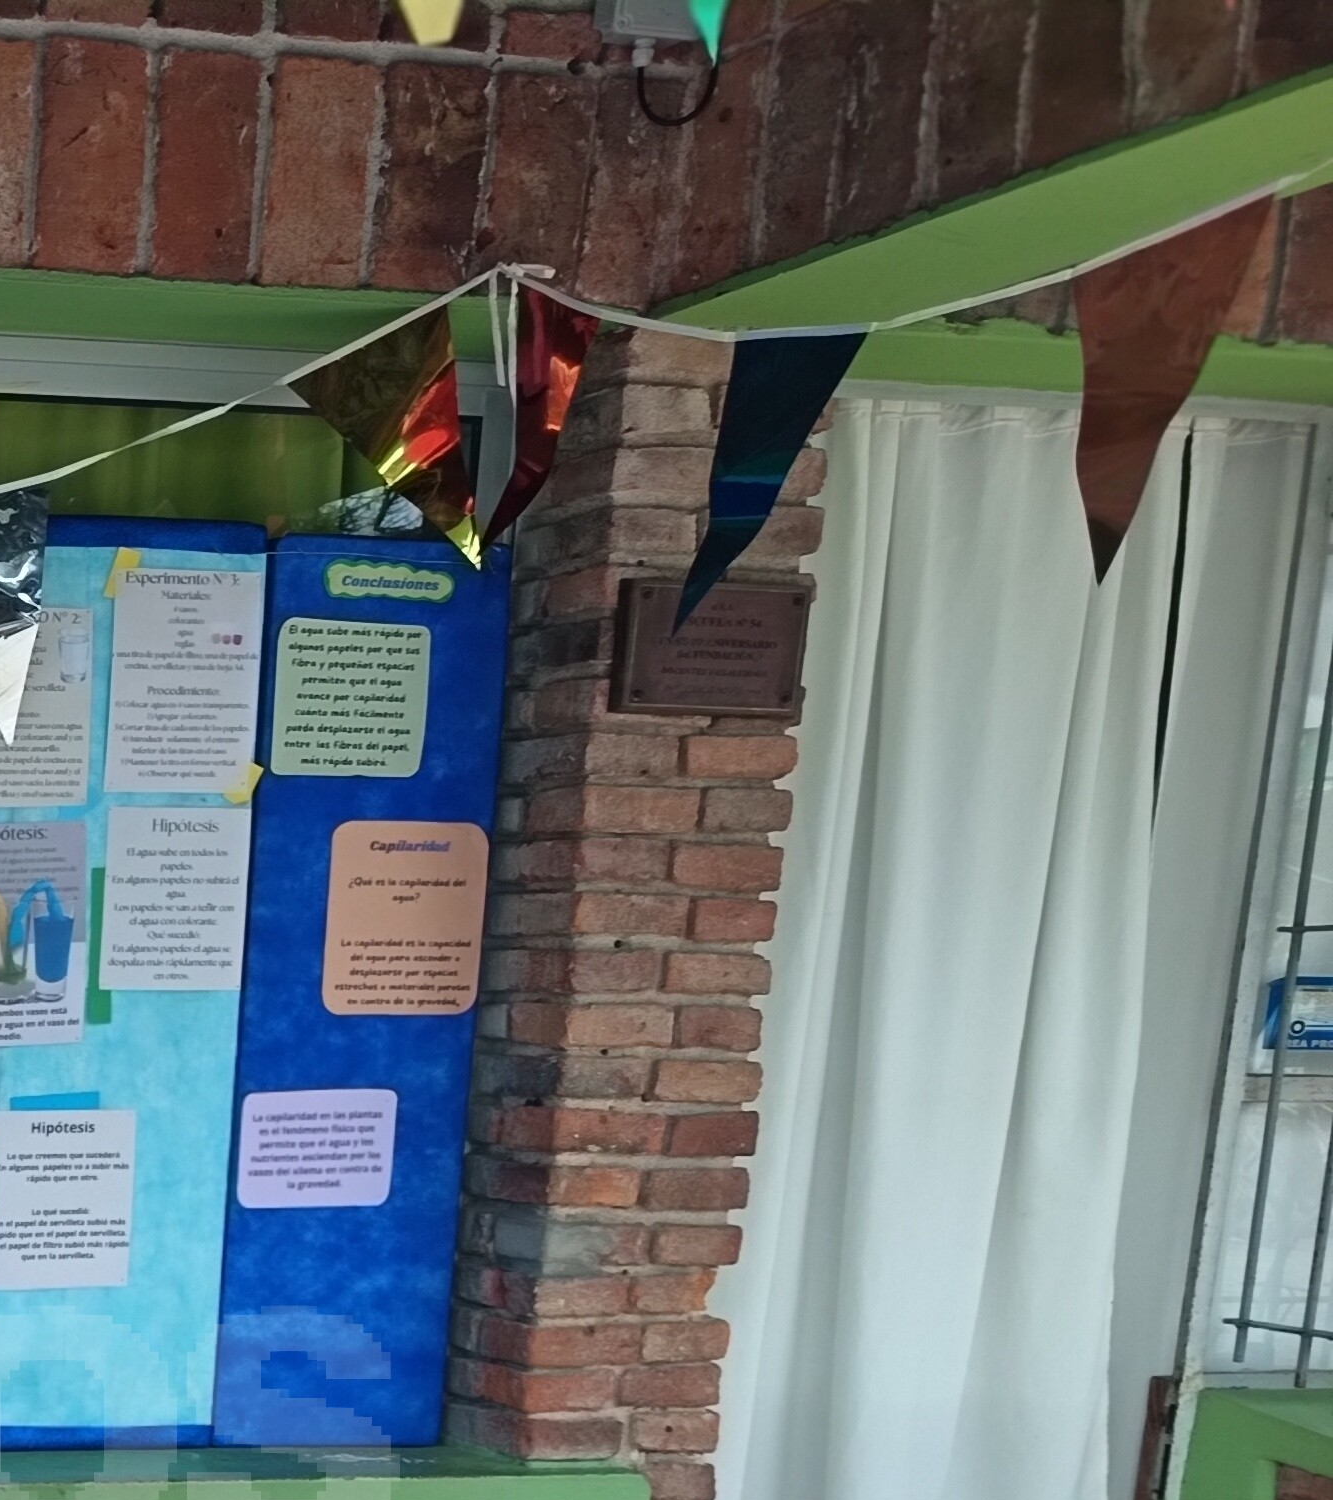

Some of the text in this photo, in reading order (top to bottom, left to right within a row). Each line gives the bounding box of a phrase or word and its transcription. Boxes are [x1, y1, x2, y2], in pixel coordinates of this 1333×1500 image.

[125, 571, 210, 587] Experimento
[342, 575, 439, 591] Conclusiones
[289, 624, 422, 641] El agua sube más rápido por
[289, 643, 420, 656] algunos papeles por que sus
[302, 676, 402, 688] permiten que el agua
[286, 724, 411, 737] pueda desplazarse el agua
[152, 818, 219, 836] Hipótesis
[370, 840, 450, 853] Capilaridad
[31, 1121, 95, 1137] Hipótesis
